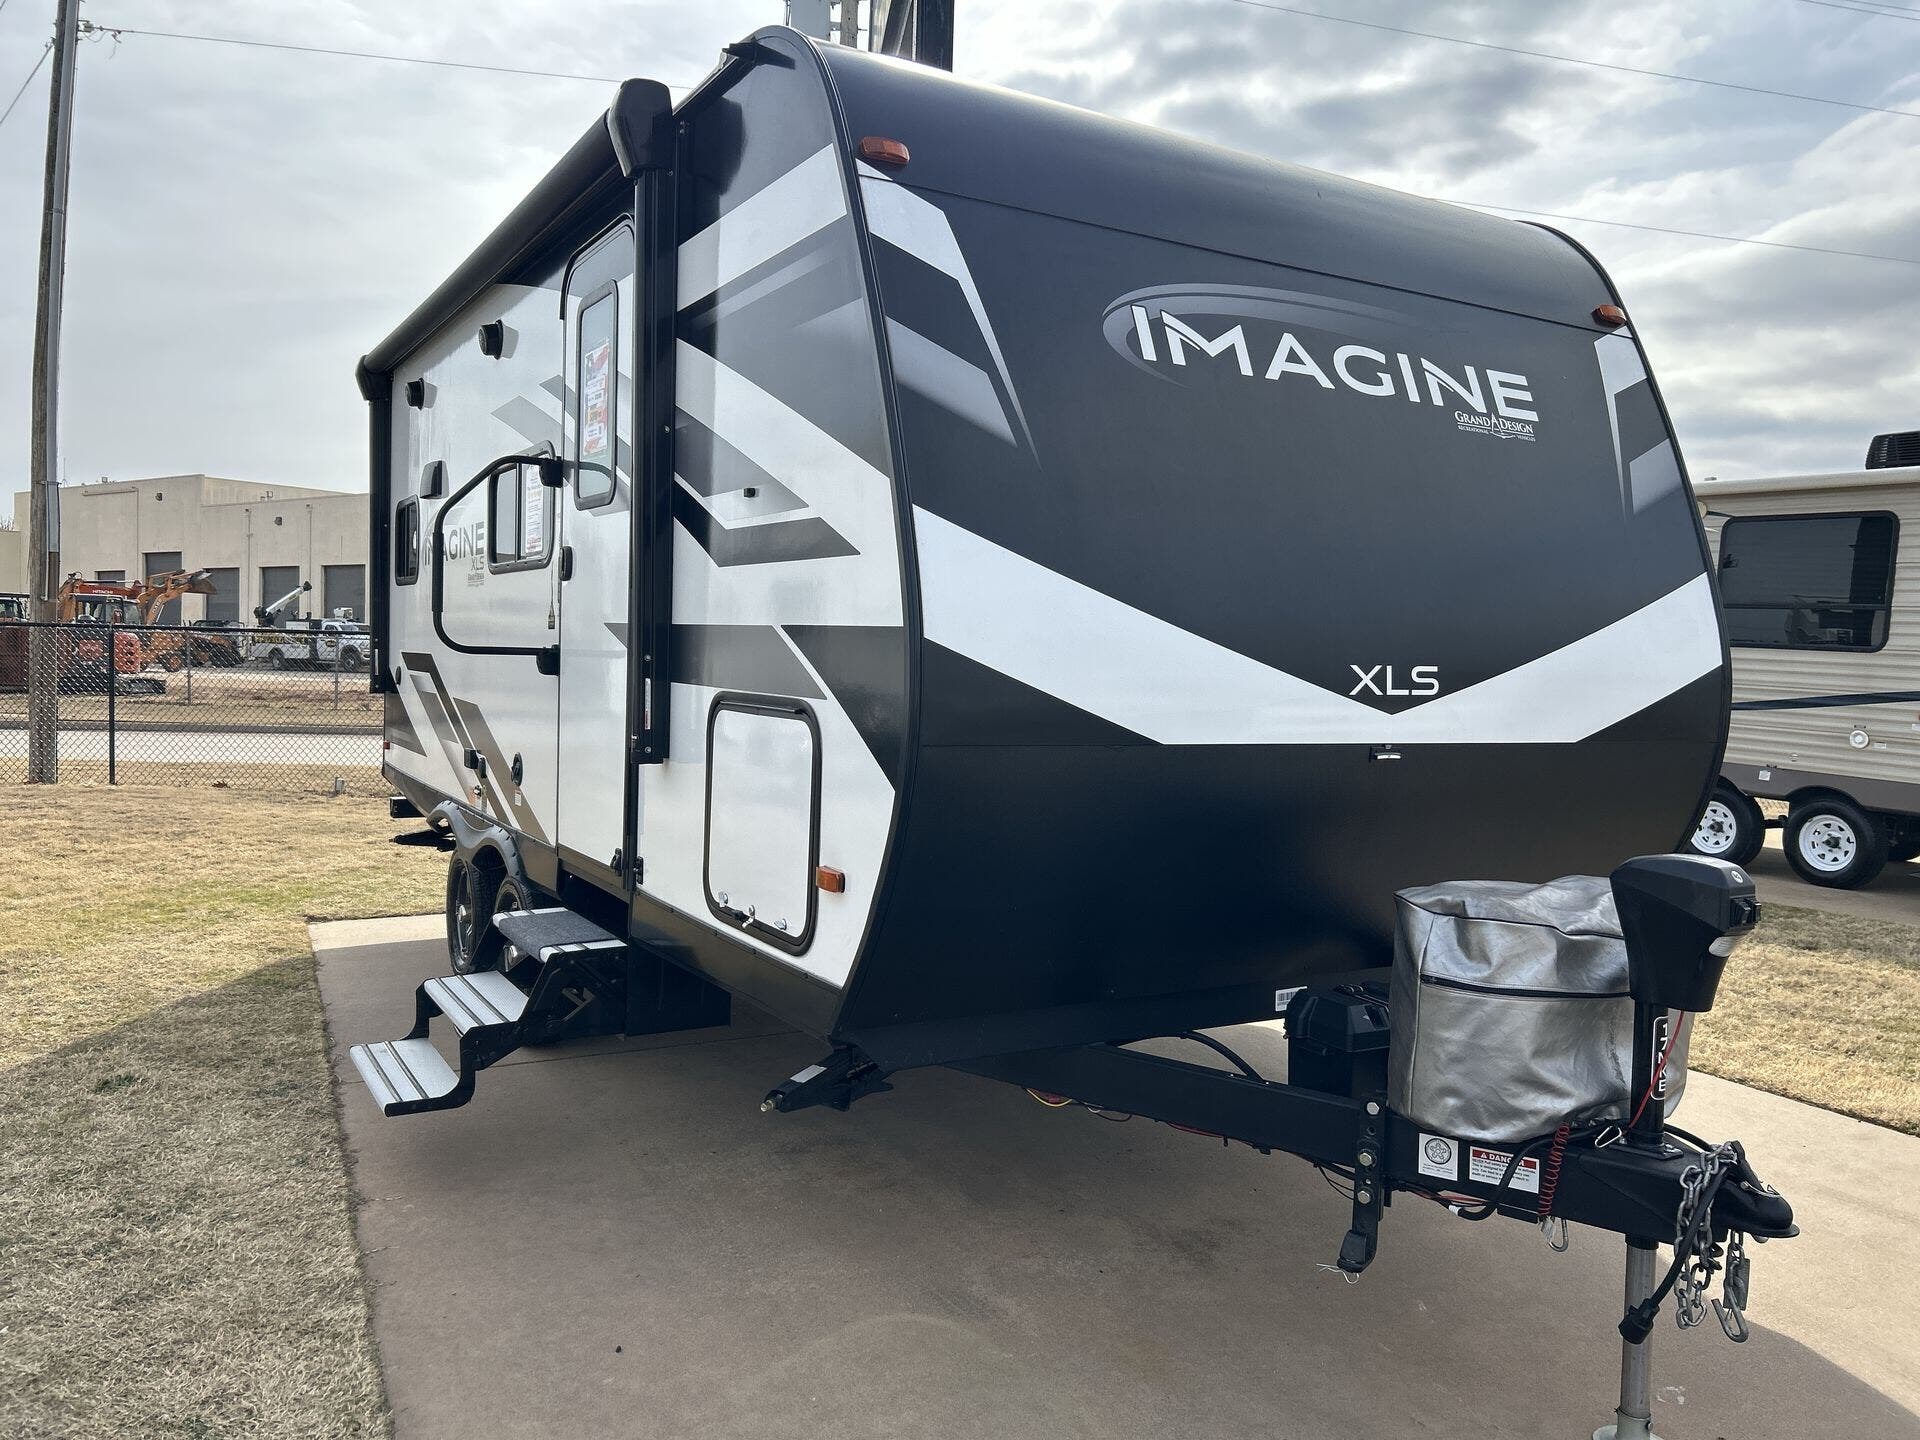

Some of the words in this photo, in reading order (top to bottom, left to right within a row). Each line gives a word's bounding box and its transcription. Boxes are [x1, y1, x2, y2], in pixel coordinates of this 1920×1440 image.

[1130, 305, 1539, 421] IMAGINE
[1455, 410, 1491, 427] GRAND
[1499, 418, 1534, 434] DESIGN
[470, 556, 485, 571] XLS
[1348, 664, 1440, 696] XLS
[1489, 1153, 1525, 1166] DANGR
